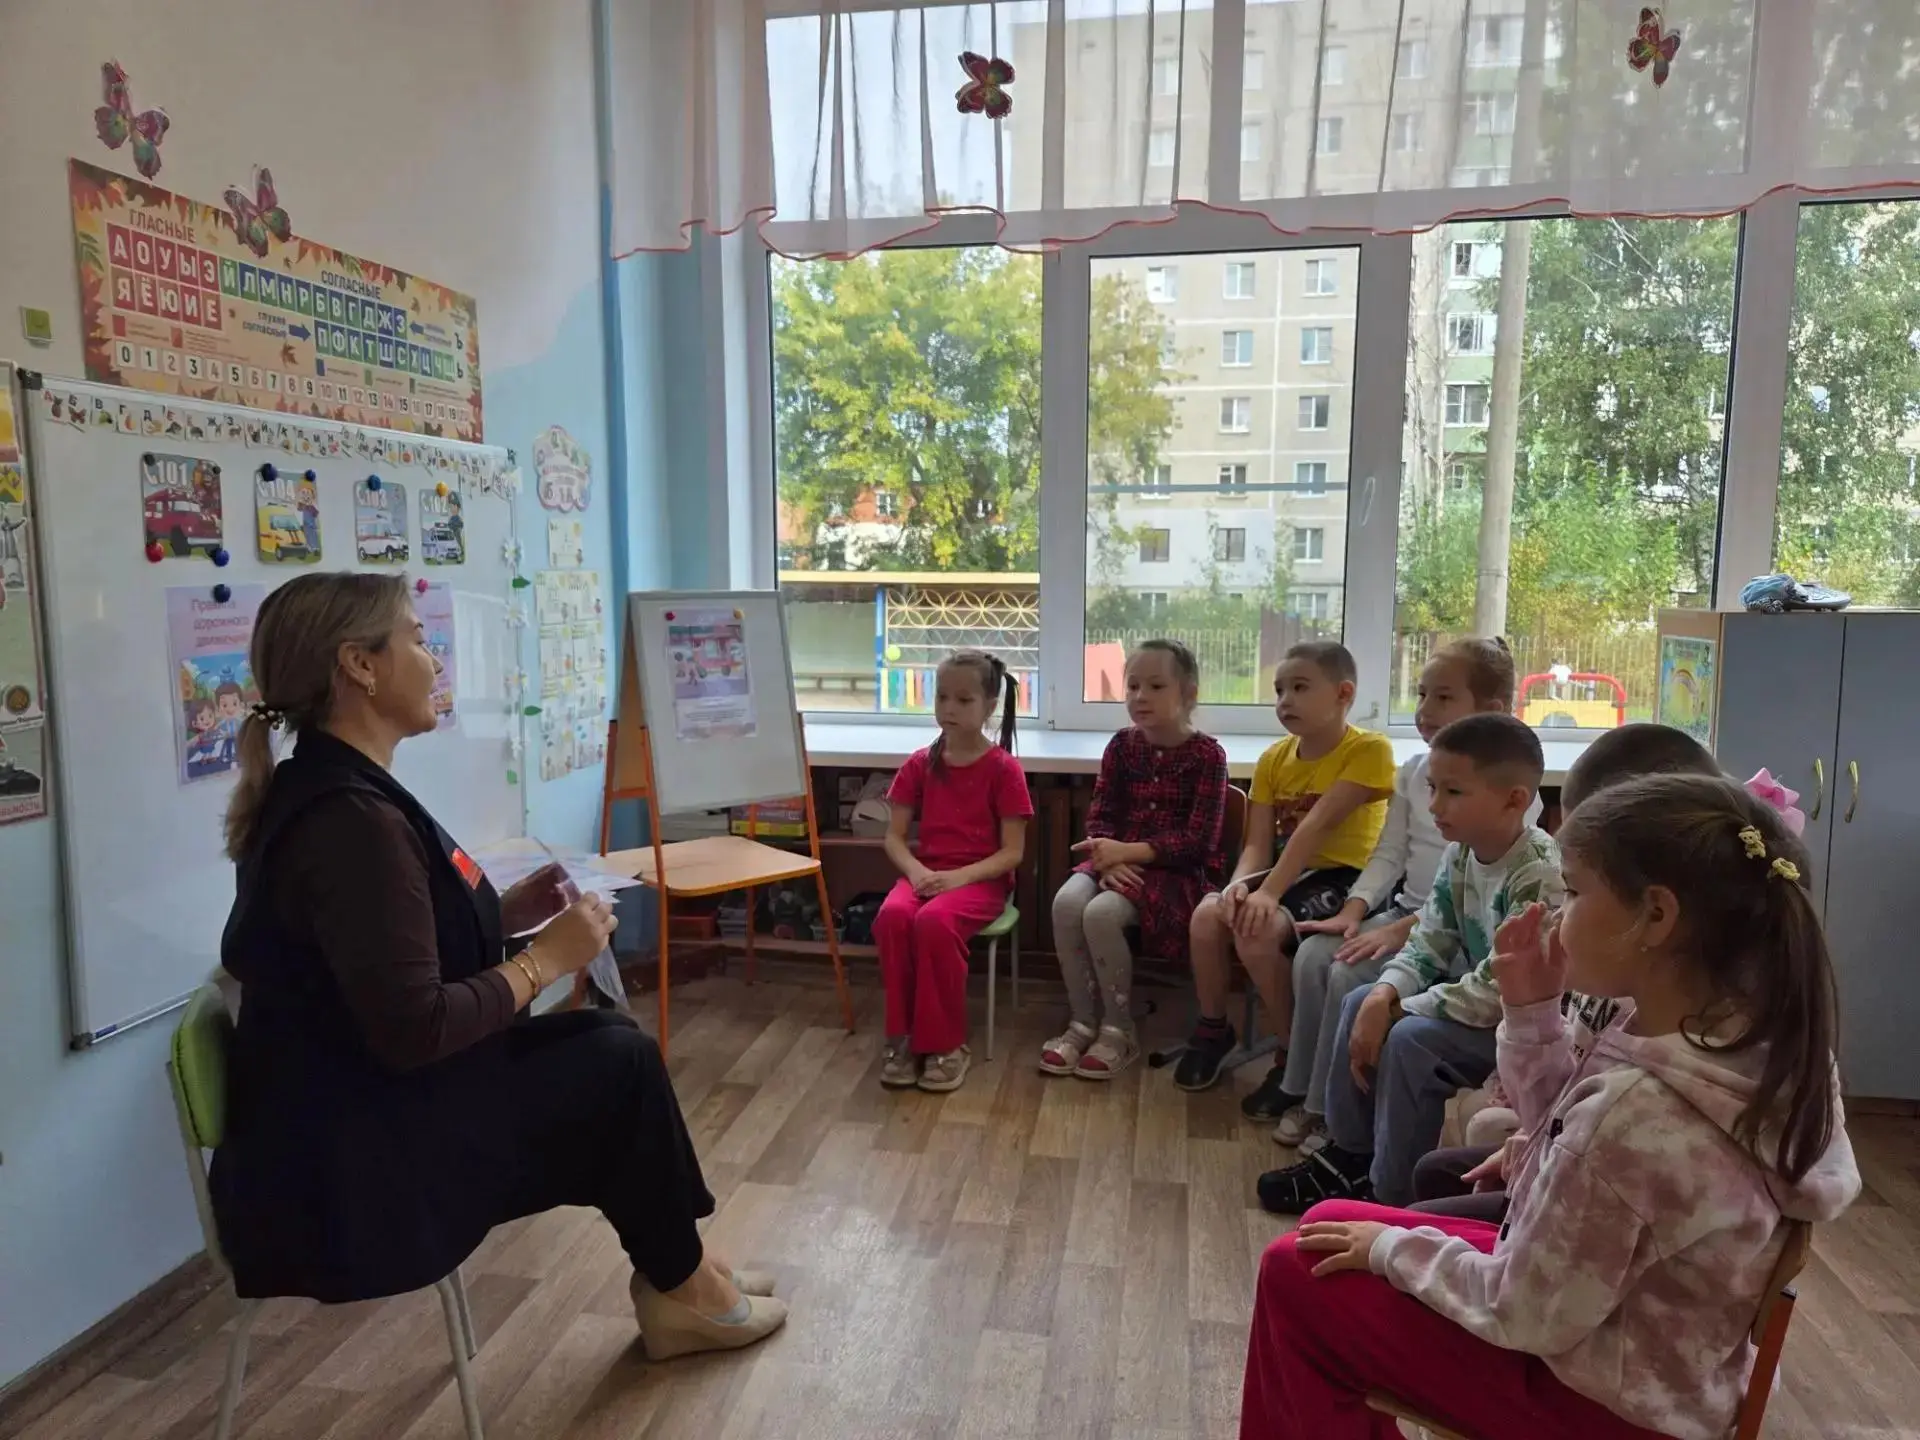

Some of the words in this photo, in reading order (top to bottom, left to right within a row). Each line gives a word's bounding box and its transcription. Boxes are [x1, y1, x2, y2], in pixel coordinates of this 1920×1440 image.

[129, 209, 196, 243] ГЛАСНЫЕ
[113, 233, 128, 259] А
[136, 240, 150, 265] О
[158, 245, 172, 270] У
[180, 252, 196, 278] Ы
[203, 259, 215, 284] Э
[223, 260, 235, 289] Й
[244, 272, 256, 294] Л
[260, 277, 276, 300] М
[281, 282, 293, 304] Н
[299, 286, 309, 308] Р
[316, 292, 326, 313] Б
[331, 296, 341, 317] В
[347, 301, 356, 321] Г
[363, 305, 376, 329] Д
[378, 309, 393, 330] Ж
[396, 314, 406, 334] З
[117, 277, 131, 302] Я
[140, 276, 154, 307] Ё
[160, 287, 178, 313] Ю
[184, 293, 198, 318] И
[207, 299, 218, 322] Е
[321, 269, 381, 300] СОГЛАСНЫЕ
[317, 326, 327, 347] П
[332, 328, 345, 352] Ф
[349, 334, 360, 356] К
[365, 339, 374, 360] Т
[379, 341, 393, 362] Ш
[397, 347, 406, 366] С
[421, 352, 431, 374] Ц
[121, 346, 131, 363] 0
[145, 351, 152, 367] 1
[168, 355, 177, 372] 2
[189, 358, 198, 375] 3
[210, 361, 219, 378] 4
[231, 366, 240, 382] 5
[251, 370, 259, 385] 6
[270, 374, 277, 388] 7
[288, 377, 296, 392] 8
[306, 381, 313, 395] 9
[321, 384, 332, 399] 10
[338, 386, 348, 400] 11
[352, 389, 364, 403] 12
[368, 392, 378, 406] 13
[383, 395, 393, 409] 14
[400, 398, 408, 412] 15
[425, 402, 433, 416] 17
[448, 407, 456, 420] 19
[157, 461, 188, 487] 101
[271, 478, 296, 501] 104
[429, 495, 448, 514] 102
